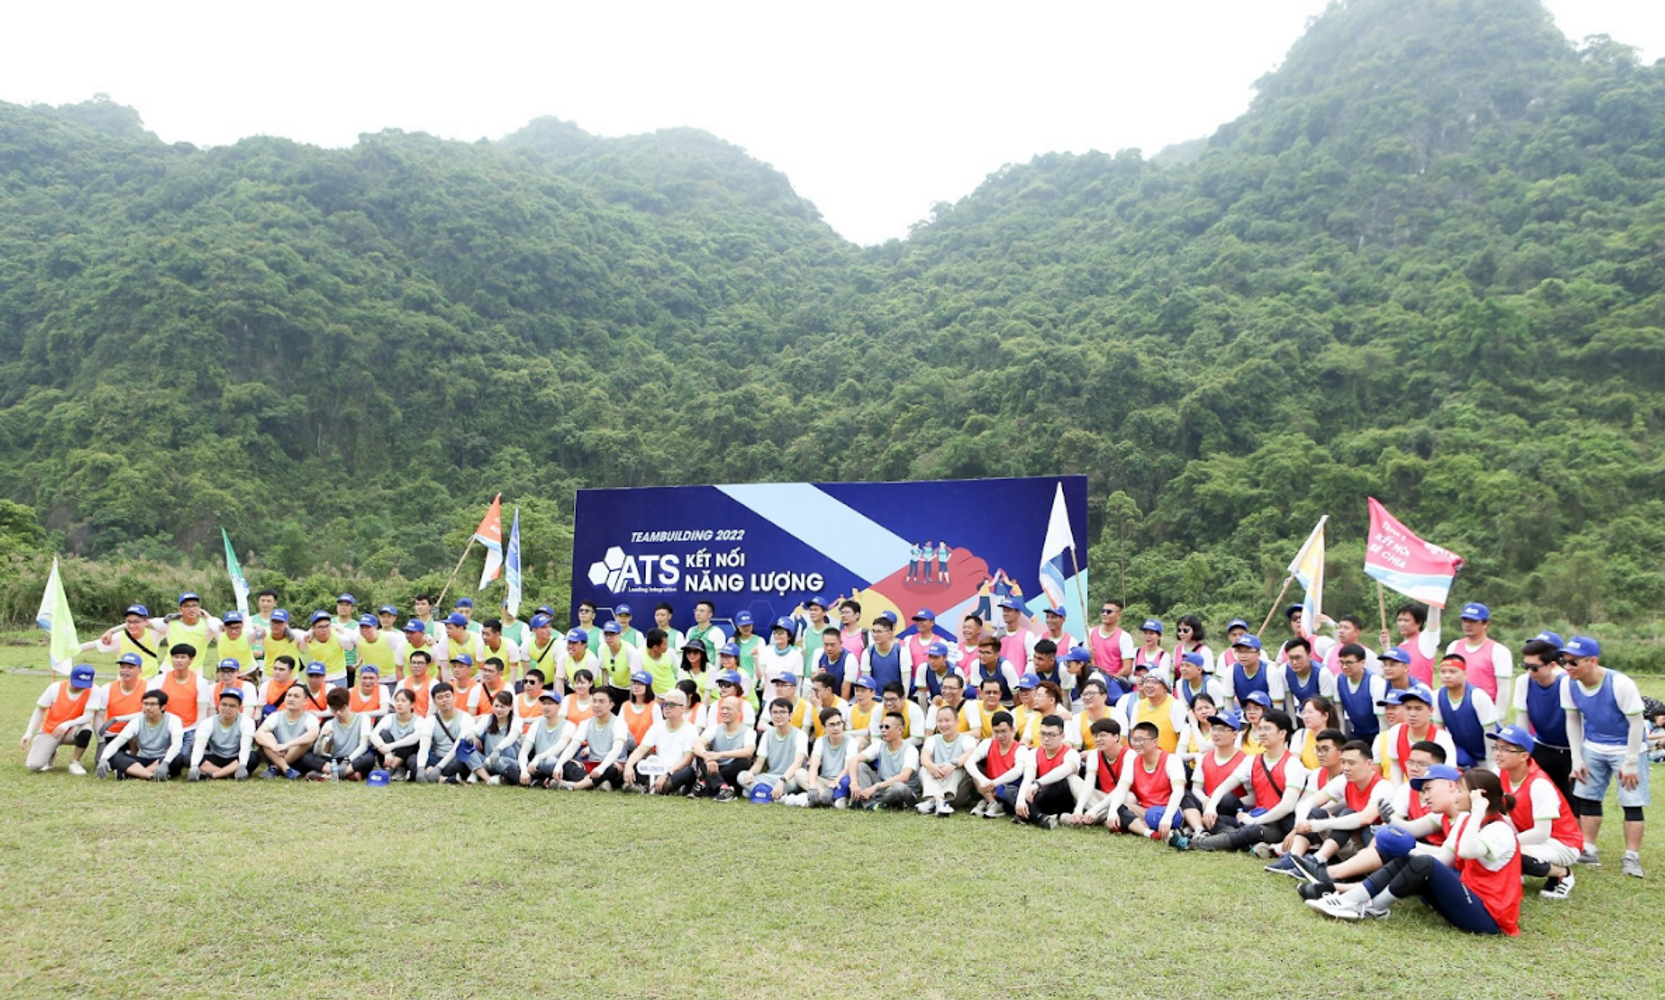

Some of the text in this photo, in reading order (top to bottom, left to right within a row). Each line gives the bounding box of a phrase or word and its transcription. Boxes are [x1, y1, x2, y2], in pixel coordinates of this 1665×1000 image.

[631, 529, 745, 543] TEAMBUILDING 2022
[686, 547, 745, 568] KẾT NỐI
[1381, 551, 1407, 569] CHIA
[618, 554, 680, 585] ATS
[685, 570, 824, 596] NĂNG LƯỢNG
